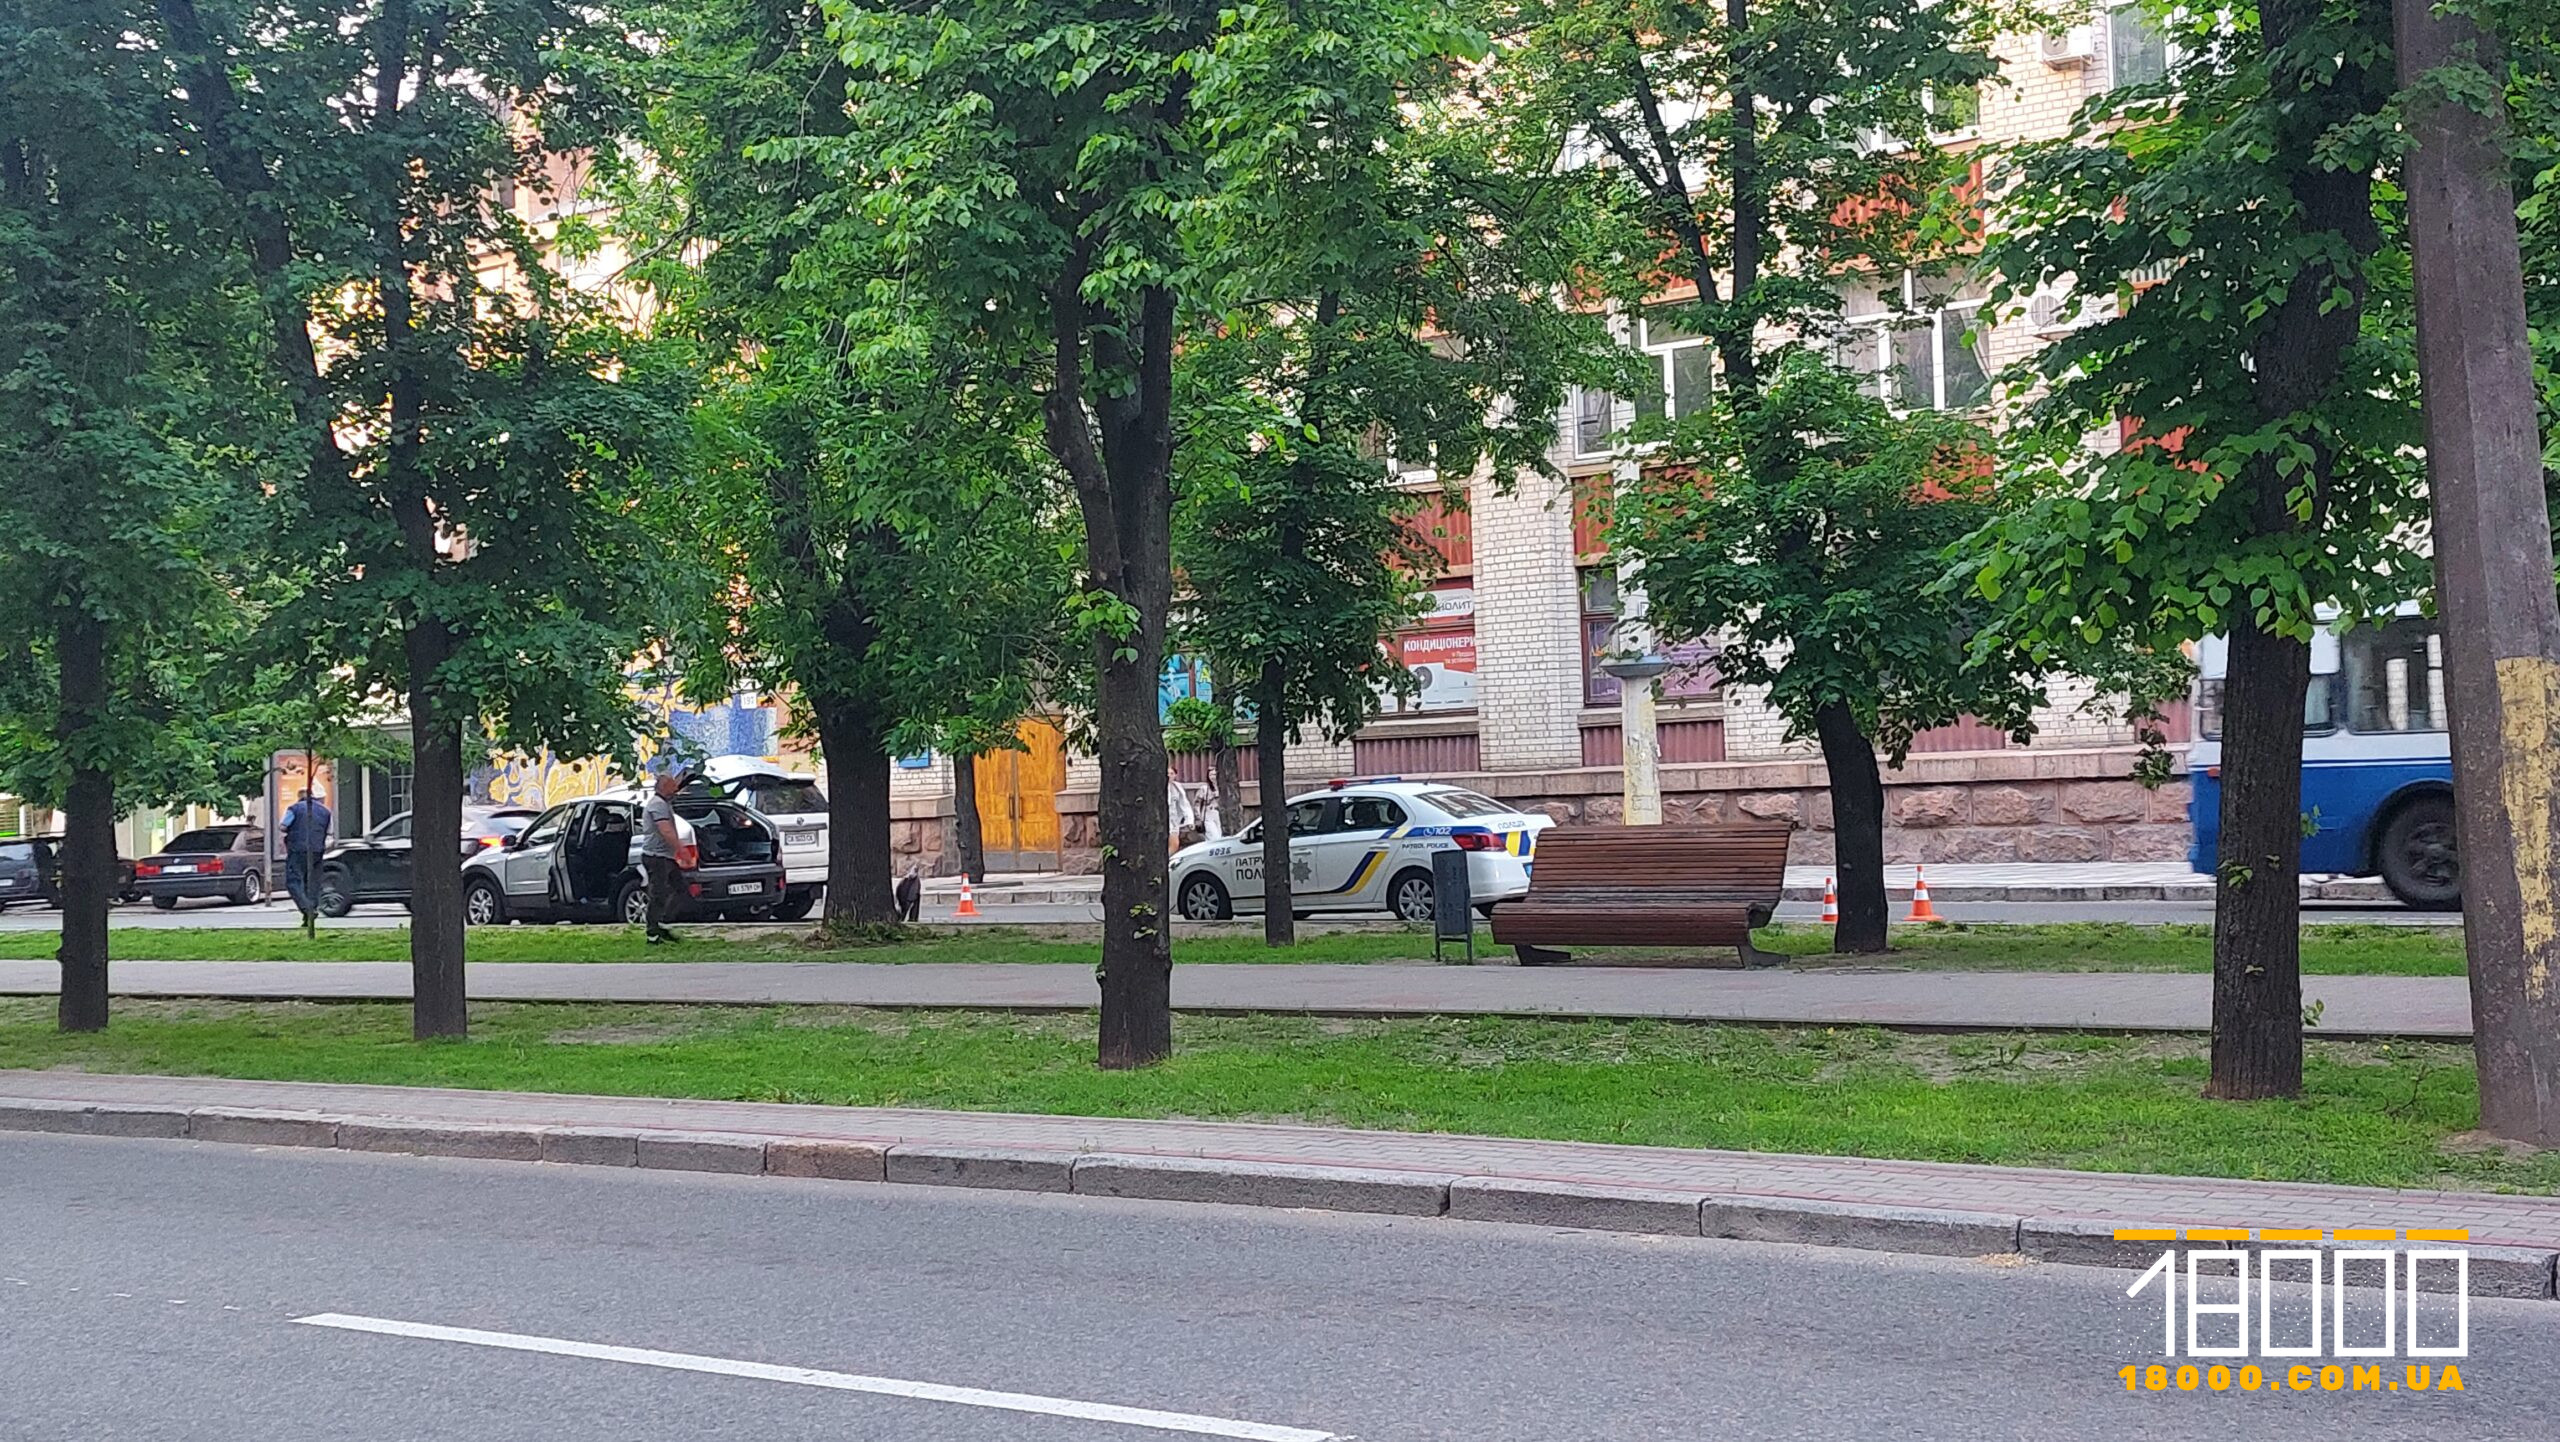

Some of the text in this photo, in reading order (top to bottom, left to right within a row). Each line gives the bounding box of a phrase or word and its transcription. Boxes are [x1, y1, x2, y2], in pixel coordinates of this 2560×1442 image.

[1433, 826, 1453, 836] 102
[1236, 857, 1265, 866] ПАТРУ
[1236, 869, 1265, 880] ПОЛІ
